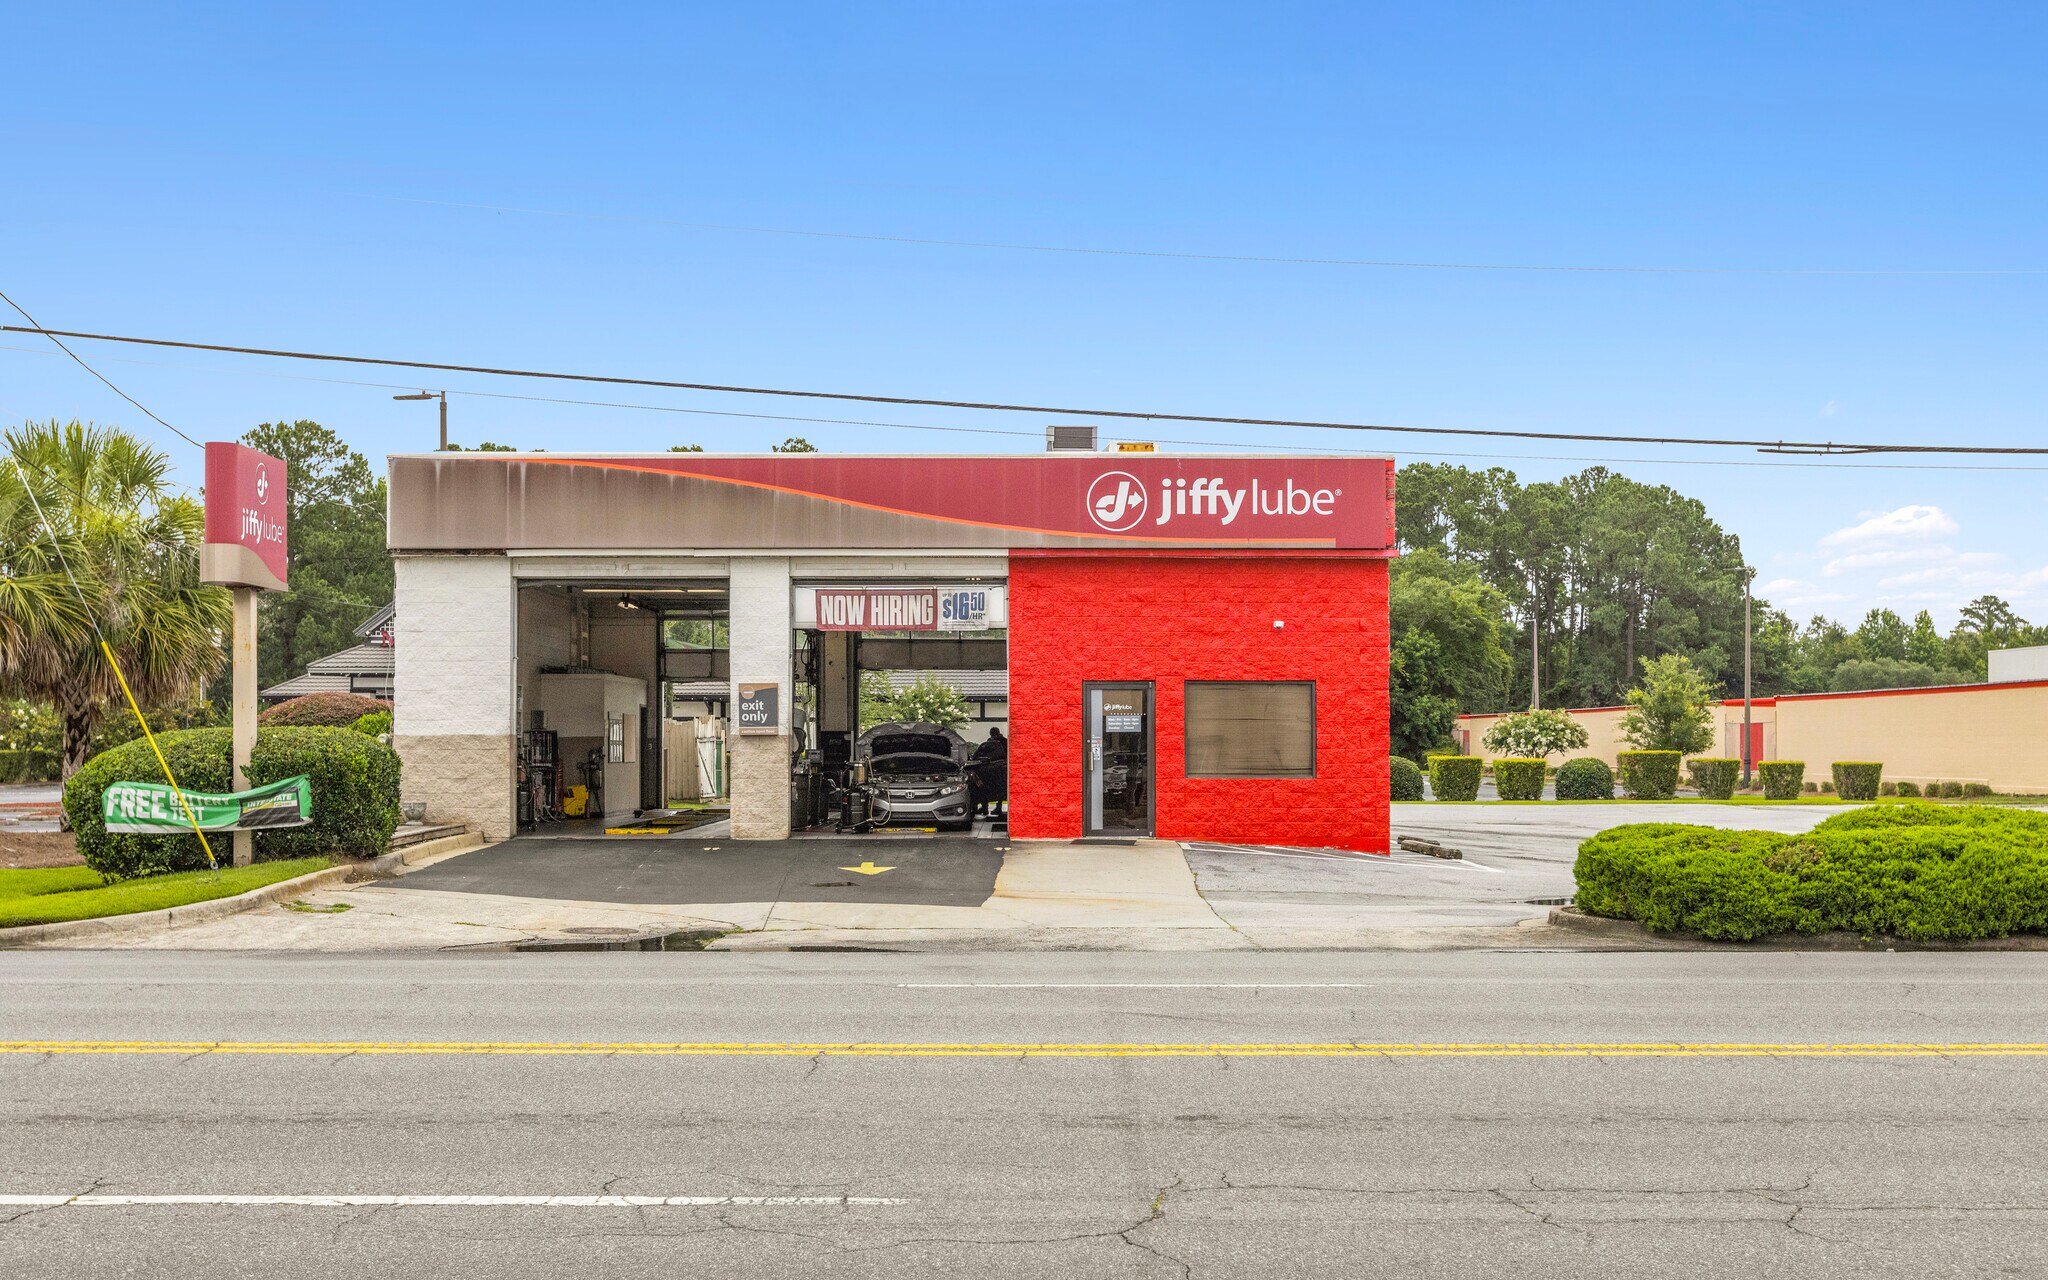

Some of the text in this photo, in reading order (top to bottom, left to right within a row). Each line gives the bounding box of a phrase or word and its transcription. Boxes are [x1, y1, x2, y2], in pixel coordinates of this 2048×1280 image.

[820, 594, 934, 626] NOW HIRING
[742, 700, 764, 710] exit
[742, 711, 768, 724] only
[106, 787, 230, 819] FREE BATTERY
[170, 806, 206, 821] TEST
